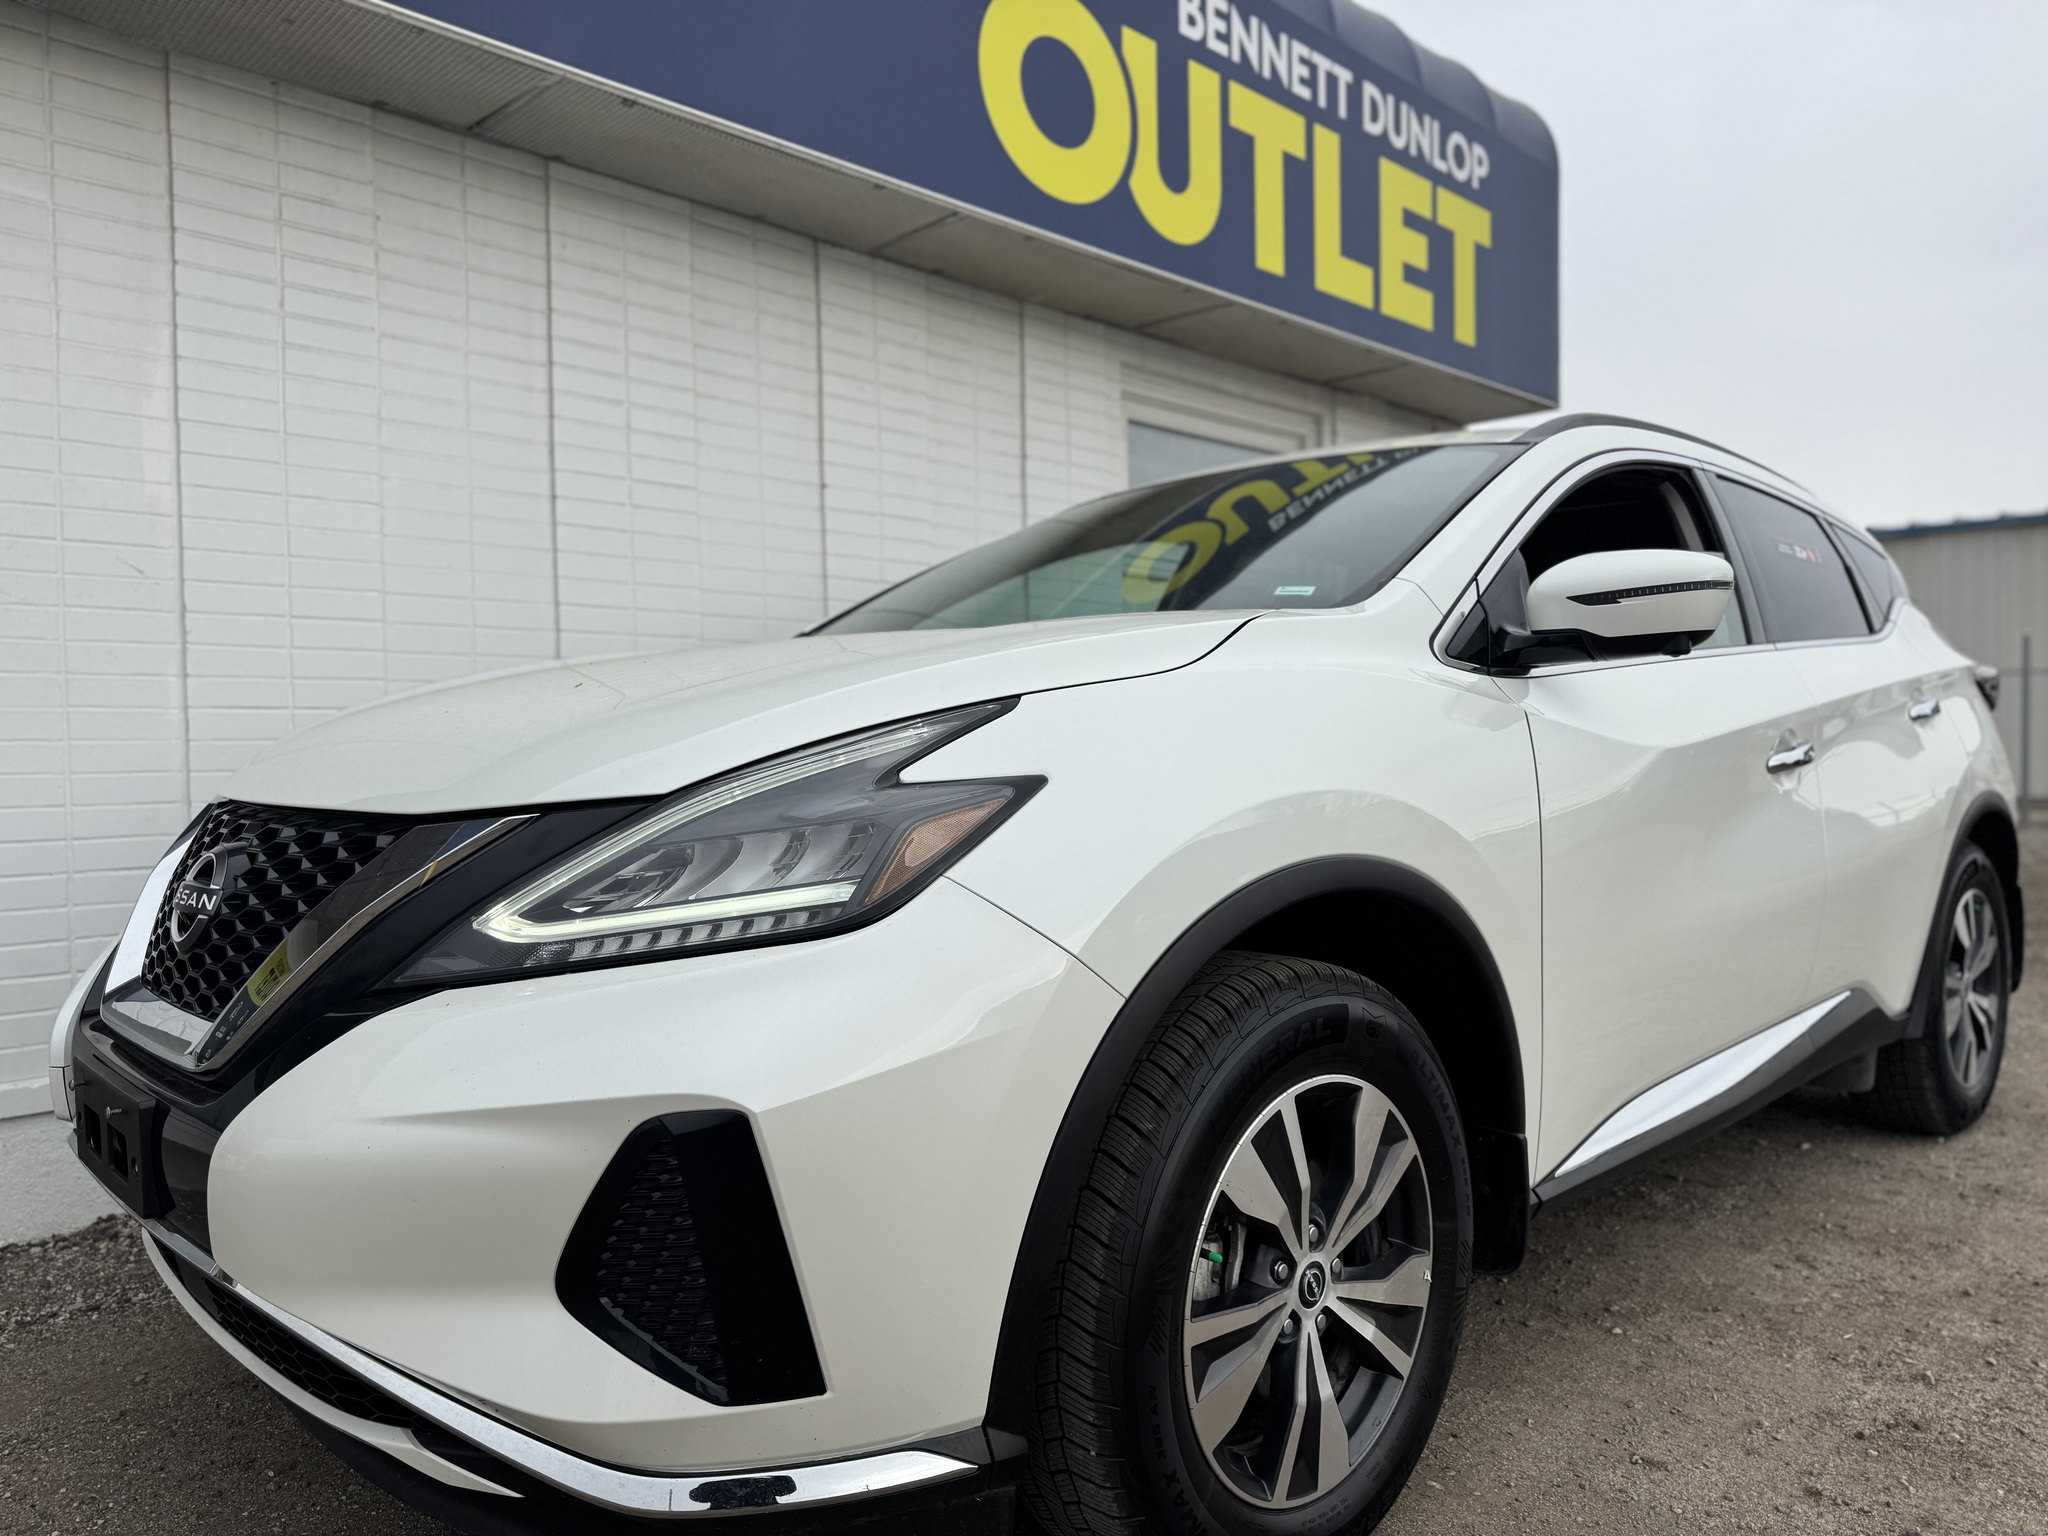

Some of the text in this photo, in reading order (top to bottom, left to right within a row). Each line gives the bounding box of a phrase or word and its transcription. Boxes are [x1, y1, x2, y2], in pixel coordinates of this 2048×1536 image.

[978, 0, 1492, 348] OUTLET
[1178, 0, 1490, 189] BENNETT DUNLOP
